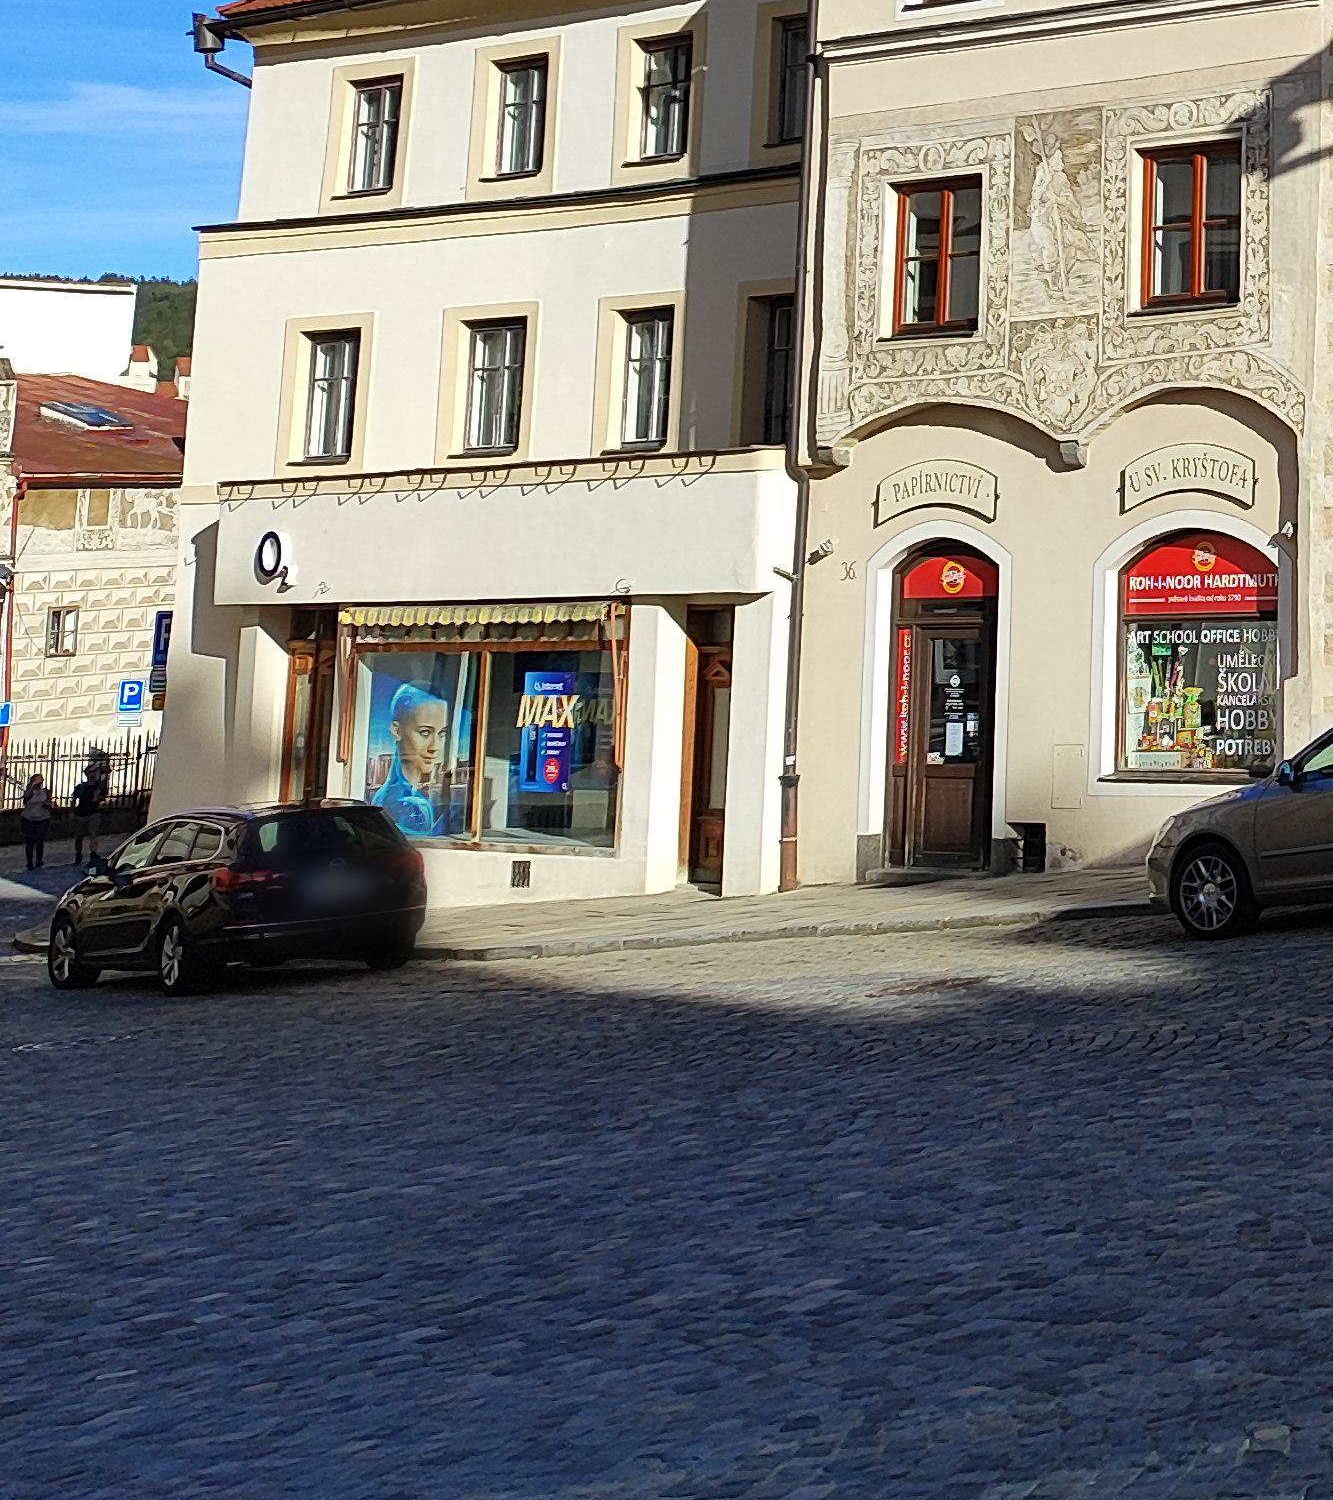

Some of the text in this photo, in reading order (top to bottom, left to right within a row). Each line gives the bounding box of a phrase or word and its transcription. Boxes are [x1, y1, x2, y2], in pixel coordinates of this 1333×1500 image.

[1129, 453, 1249, 493] U SV. KRYŠTOFA
[892, 470, 984, 503] PAPÍRNICTVÍ
[839, 560, 857, 582] 36
[1129, 573, 1201, 591] KOH-I-NOOR
[1128, 630, 1152, 644] ART
[1152, 629, 1199, 644] SCHOOL
[1201, 629, 1241, 643] OFFICE
[123, 683, 139, 703] P
[516, 694, 580, 728] MAX
